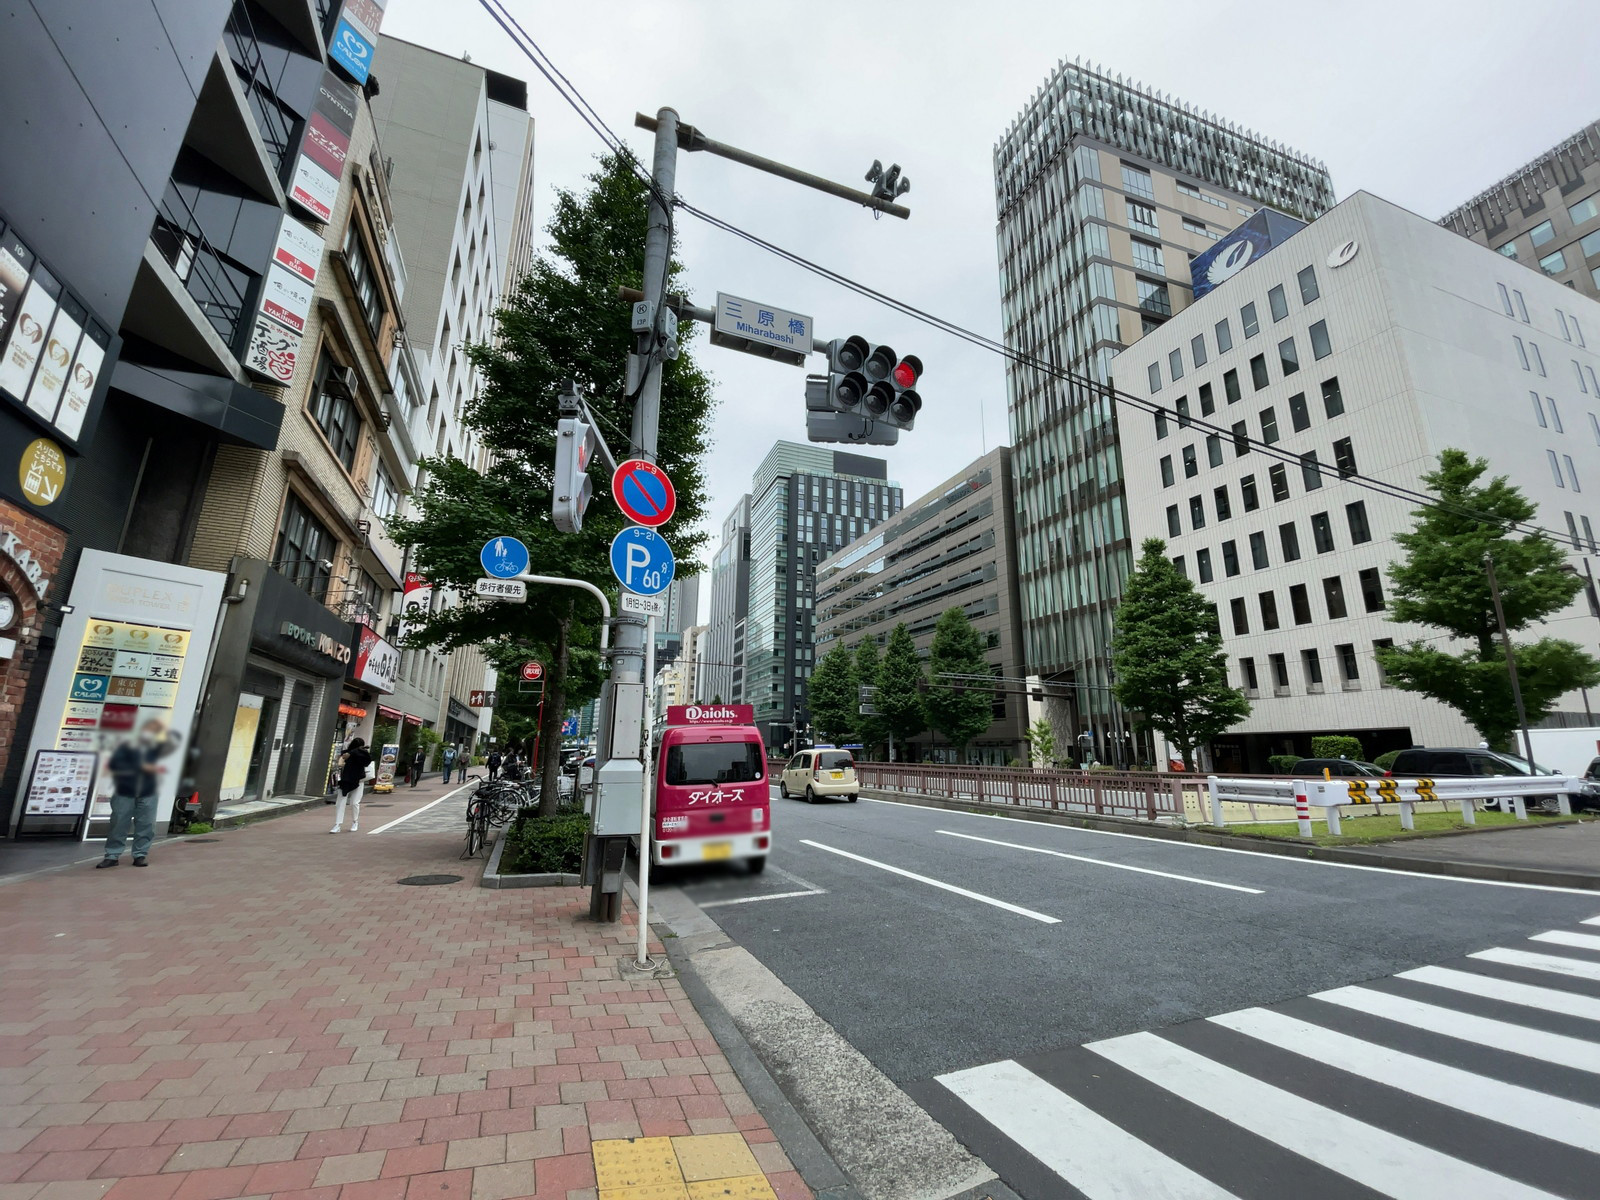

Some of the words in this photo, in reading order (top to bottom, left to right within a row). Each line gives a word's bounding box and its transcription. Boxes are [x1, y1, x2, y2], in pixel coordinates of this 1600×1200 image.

[320, 86, 353, 119] CYNTHIA
[294, 190, 329, 219] RESTAURANT
[309, 195, 317, 205] 2F
[289, 261, 303, 273] BAR
[267, 307, 300, 329] YAKINIKU
[725, 300, 805, 337] 三原橋
[255, 320, 298, 351] テング
[736, 321, 794, 345] Miharabashi
[14, 344, 35, 364] CLINIC
[251, 336, 269, 373] 酒場
[36, 441, 60, 461] 入り口は
[34, 450, 64, 475] こちらです。
[625, 542, 651, 585] P
[479, 582, 522, 595] 歩行者優先
[318, 632, 351, 665] KAIZO
[80, 655, 114, 669] ちゃんこ
[149, 666, 179, 680] 天壇
[686, 706, 735, 720] Daiohs
[688, 788, 745, 805] ダイオーズ
